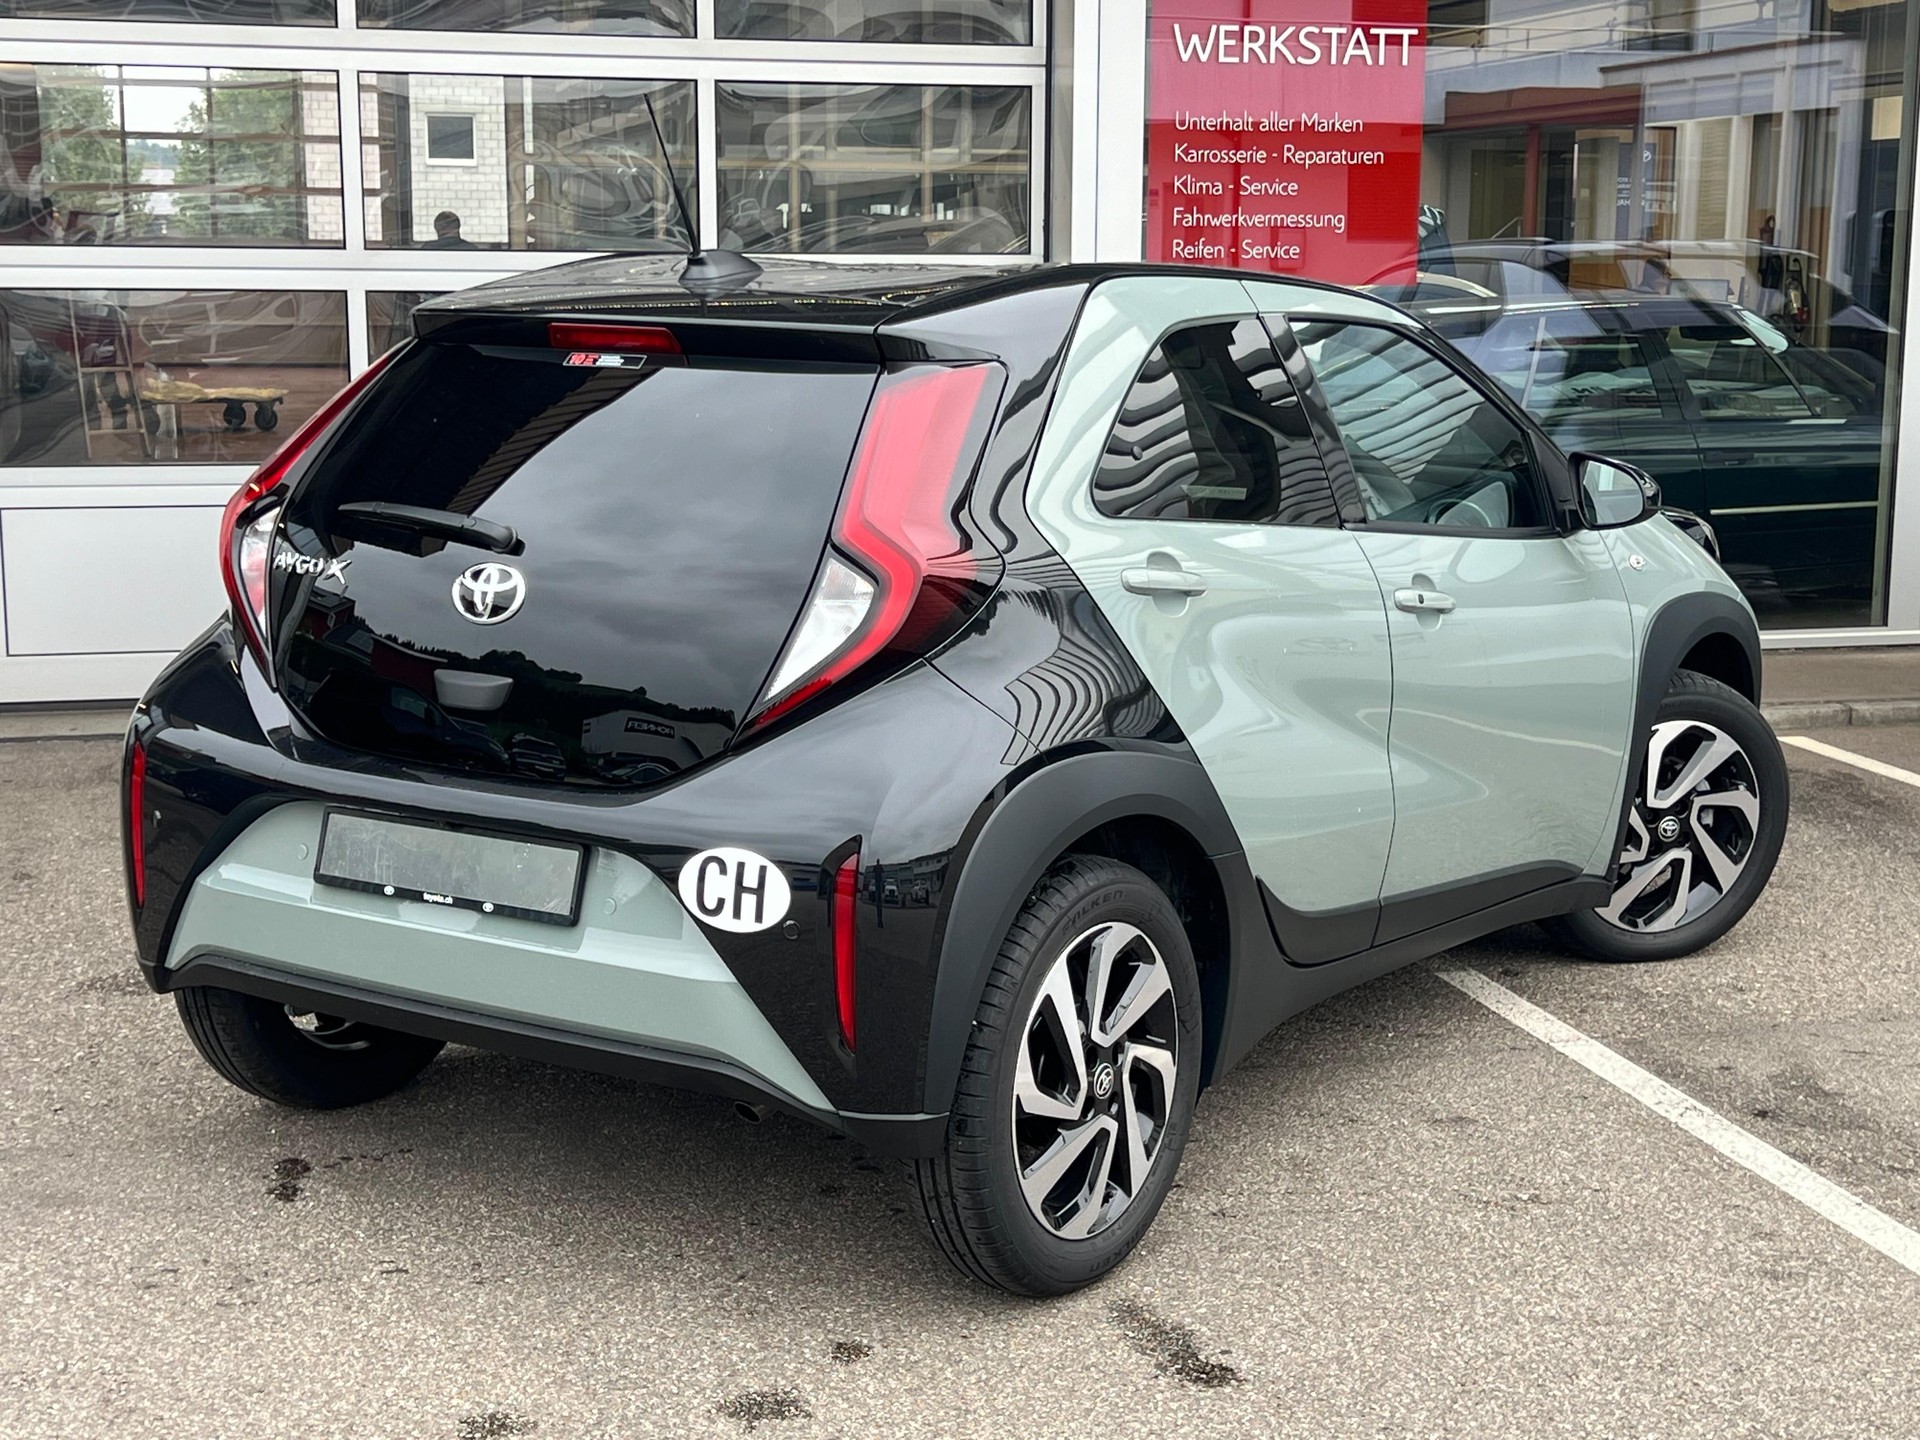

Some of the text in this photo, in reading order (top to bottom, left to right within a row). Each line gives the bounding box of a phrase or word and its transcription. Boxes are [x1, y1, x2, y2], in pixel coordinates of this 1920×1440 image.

[1173, 23, 1419, 66] WERKSTATT
[1175, 110, 1363, 133] Unterhalt aller Marken
[1174, 142, 1267, 164] Karrosserie
[1283, 144, 1384, 170] Reparaturen
[1173, 173, 1223, 195] Klima
[1239, 175, 1298, 196] Service
[1172, 206, 1346, 234] Fahrwerkvermessung
[1172, 238, 1224, 259] Reifen
[1241, 239, 1300, 259] Service
[273, 552, 352, 585] AYGO X
[696, 855, 768, 924] CH
